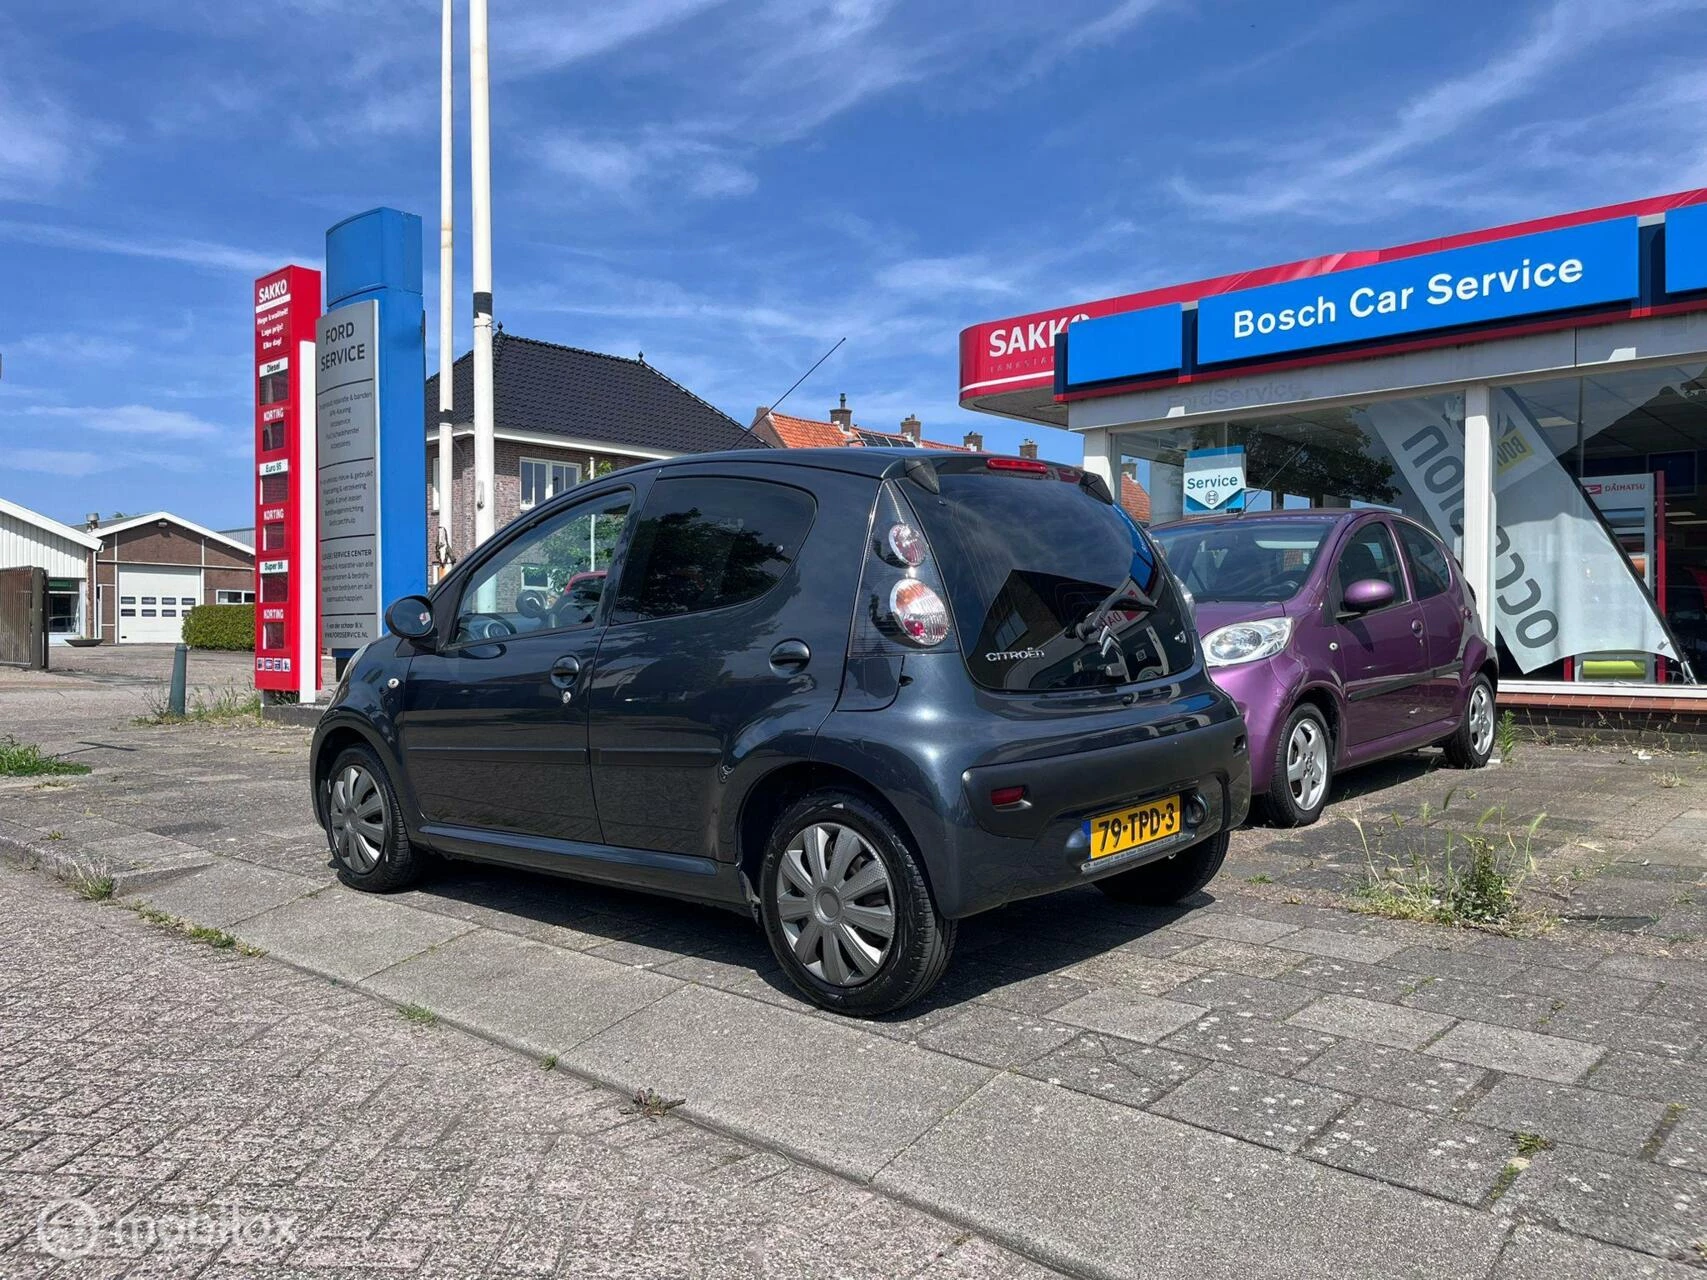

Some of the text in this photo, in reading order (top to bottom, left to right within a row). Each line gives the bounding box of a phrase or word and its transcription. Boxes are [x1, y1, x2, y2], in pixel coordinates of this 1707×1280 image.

[258, 279, 287, 303] SAKKO
[1233, 258, 1584, 339] Bosch Car Service
[325, 321, 354, 345] FORD
[989, 313, 1090, 358] SAKK
[320, 344, 365, 372] SERVICE
[266, 361, 281, 374] Diesel
[263, 407, 284, 422] KORTING
[265, 463, 276, 473] Euro
[1186, 475, 1238, 490] Service
[263, 508, 284, 520] KORTING
[351, 548, 372, 557] CENTER
[264, 562, 277, 573] Super
[263, 608, 284, 620] KORTING
[1098, 803, 1175, 852] 79-TPD-3
